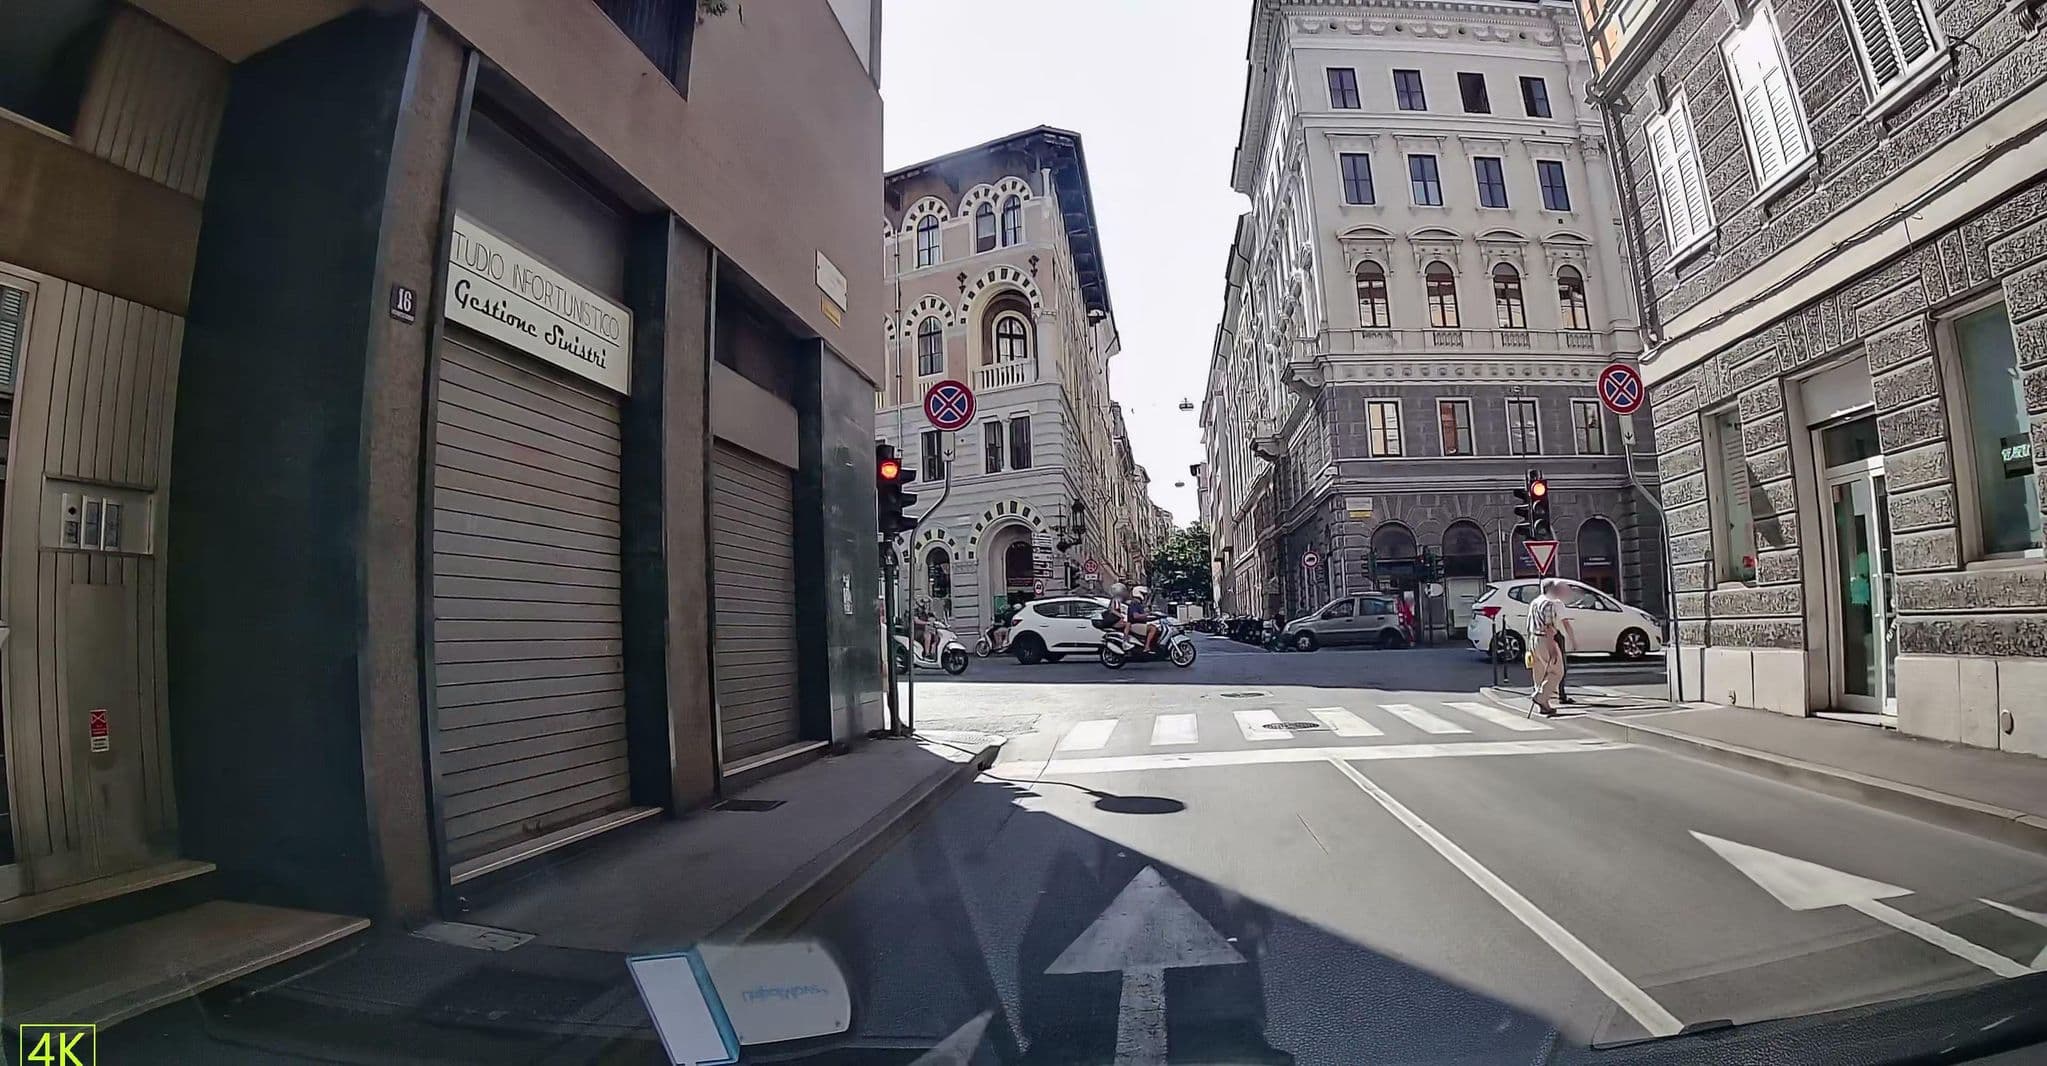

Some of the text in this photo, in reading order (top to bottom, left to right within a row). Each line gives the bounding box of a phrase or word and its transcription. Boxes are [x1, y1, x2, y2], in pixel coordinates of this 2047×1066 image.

[453, 230, 504, 280] TUDIO
[397, 287, 412, 312] 16
[455, 279, 606, 369] Gestione Sinistri
